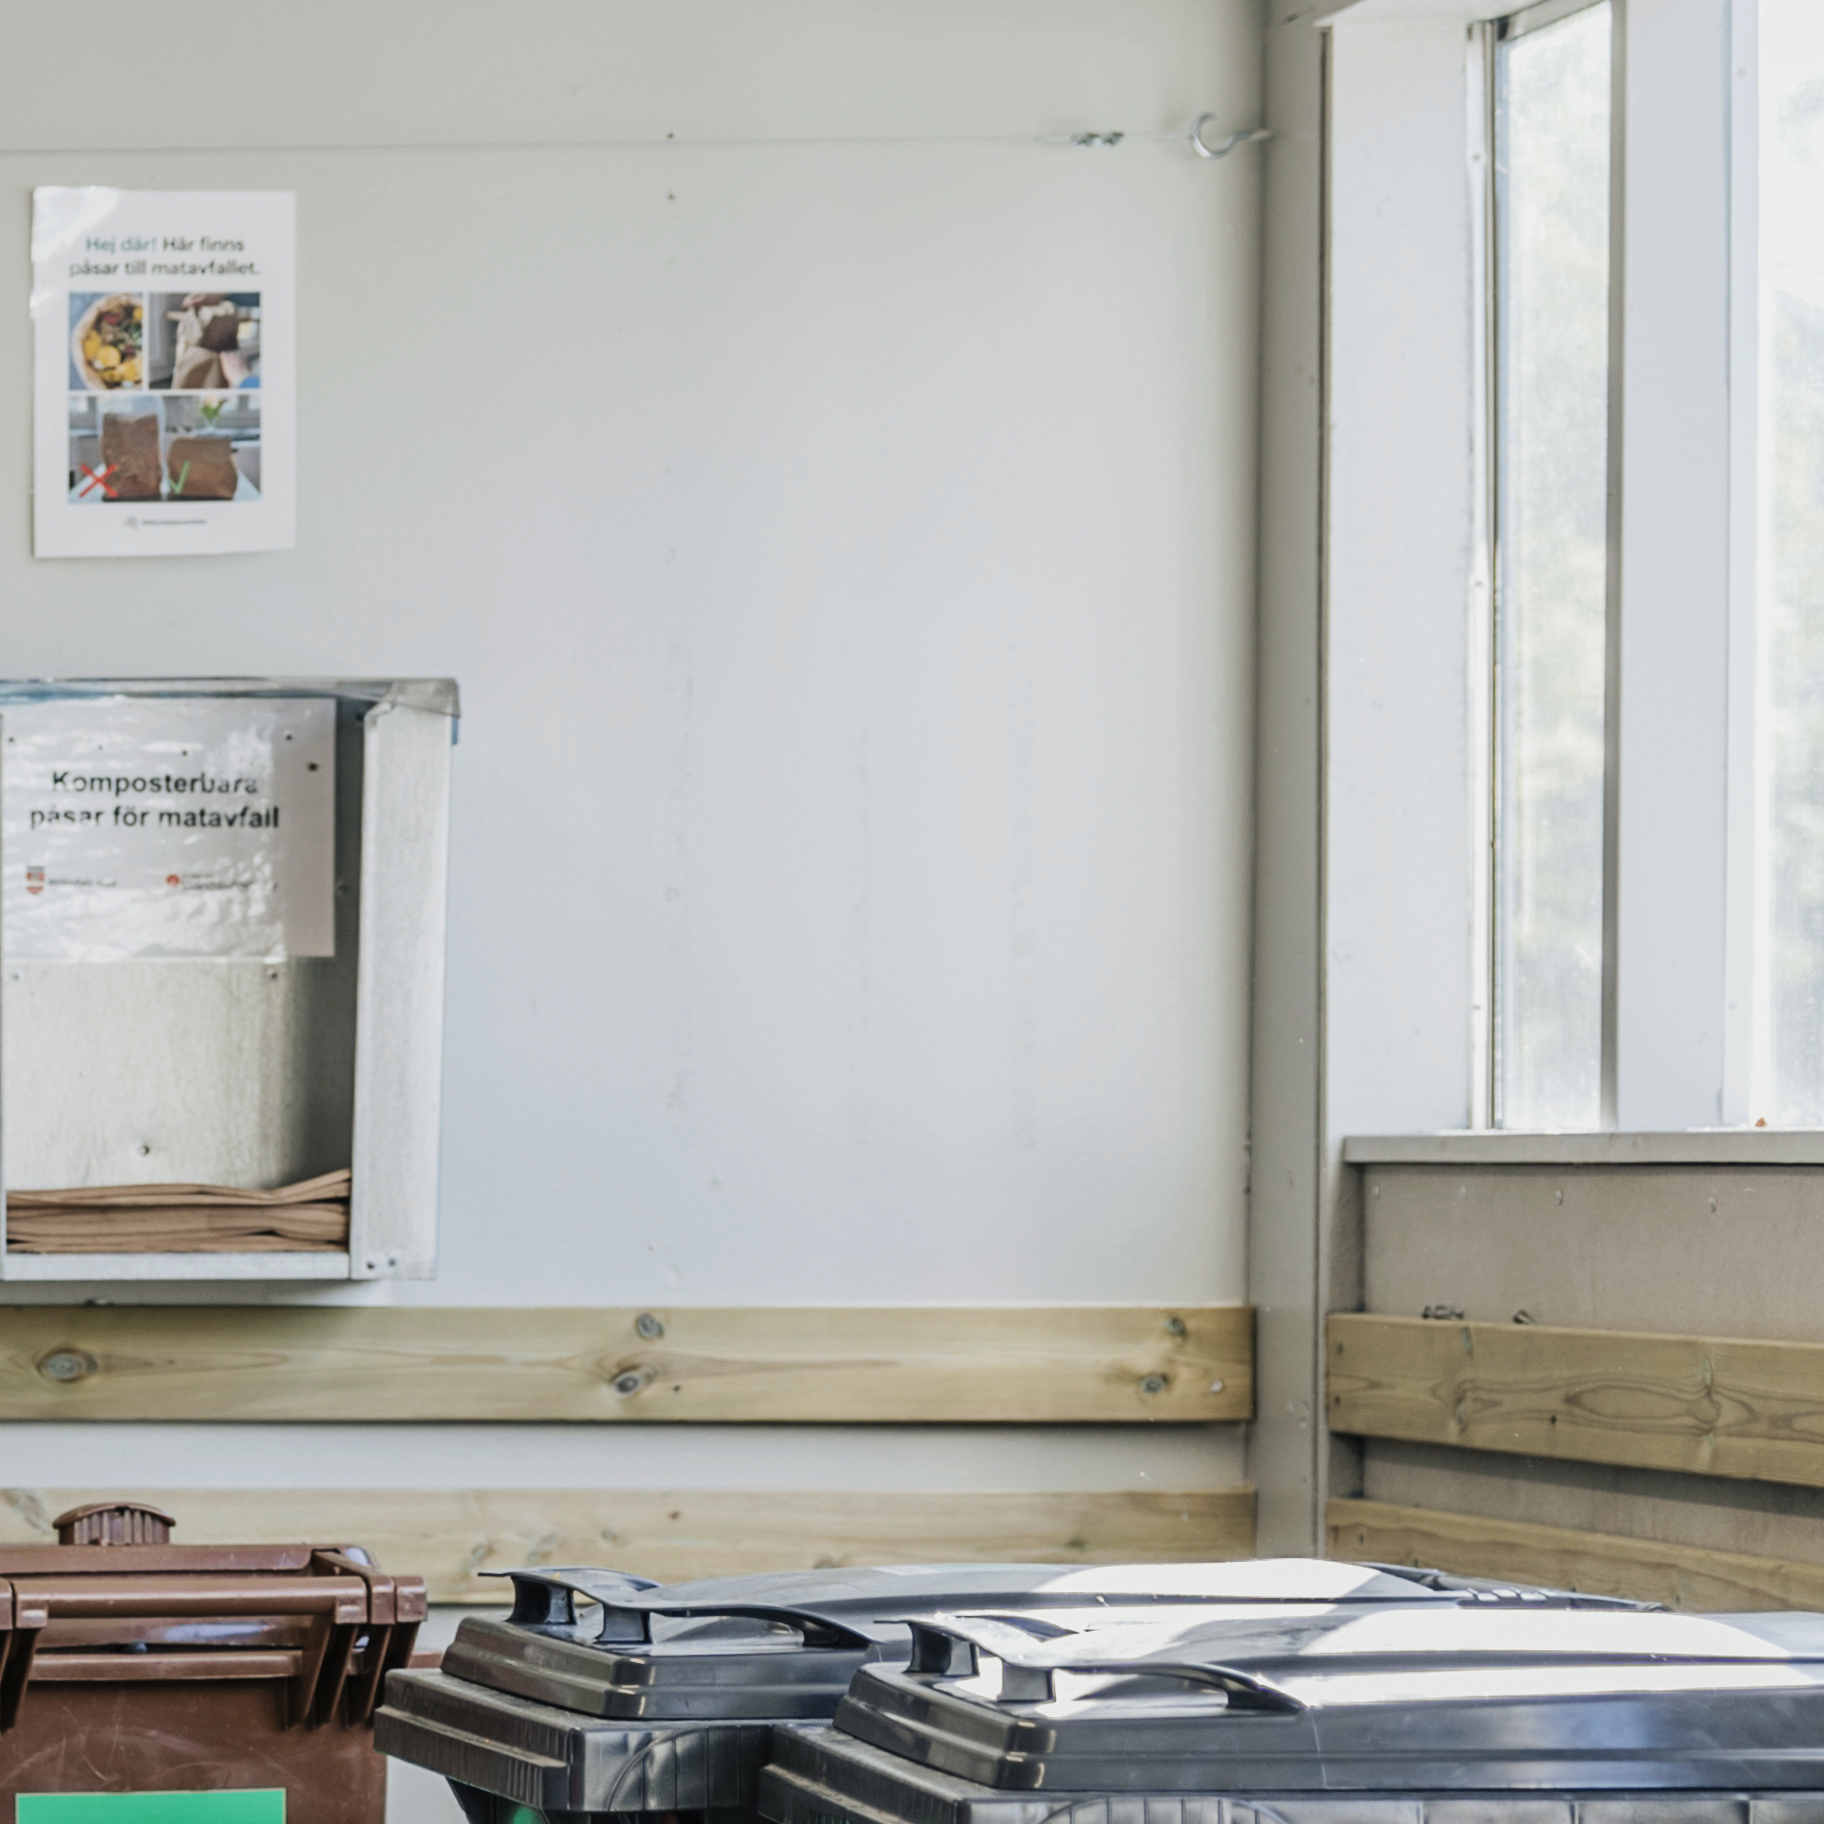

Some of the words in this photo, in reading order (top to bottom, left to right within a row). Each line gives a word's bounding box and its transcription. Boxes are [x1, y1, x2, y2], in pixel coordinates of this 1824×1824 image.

[162, 237, 194, 252] Här
[200, 236, 244, 252] finns
[70, 259, 118, 277] påsar
[124, 260, 146, 274] till
[151, 260, 261, 275] matavfallet.
[52, 771, 259, 797] Komposterbara
[30, 805, 103, 830] påsar
[113, 805, 149, 826] för
[158, 804, 280, 828] matavfall
